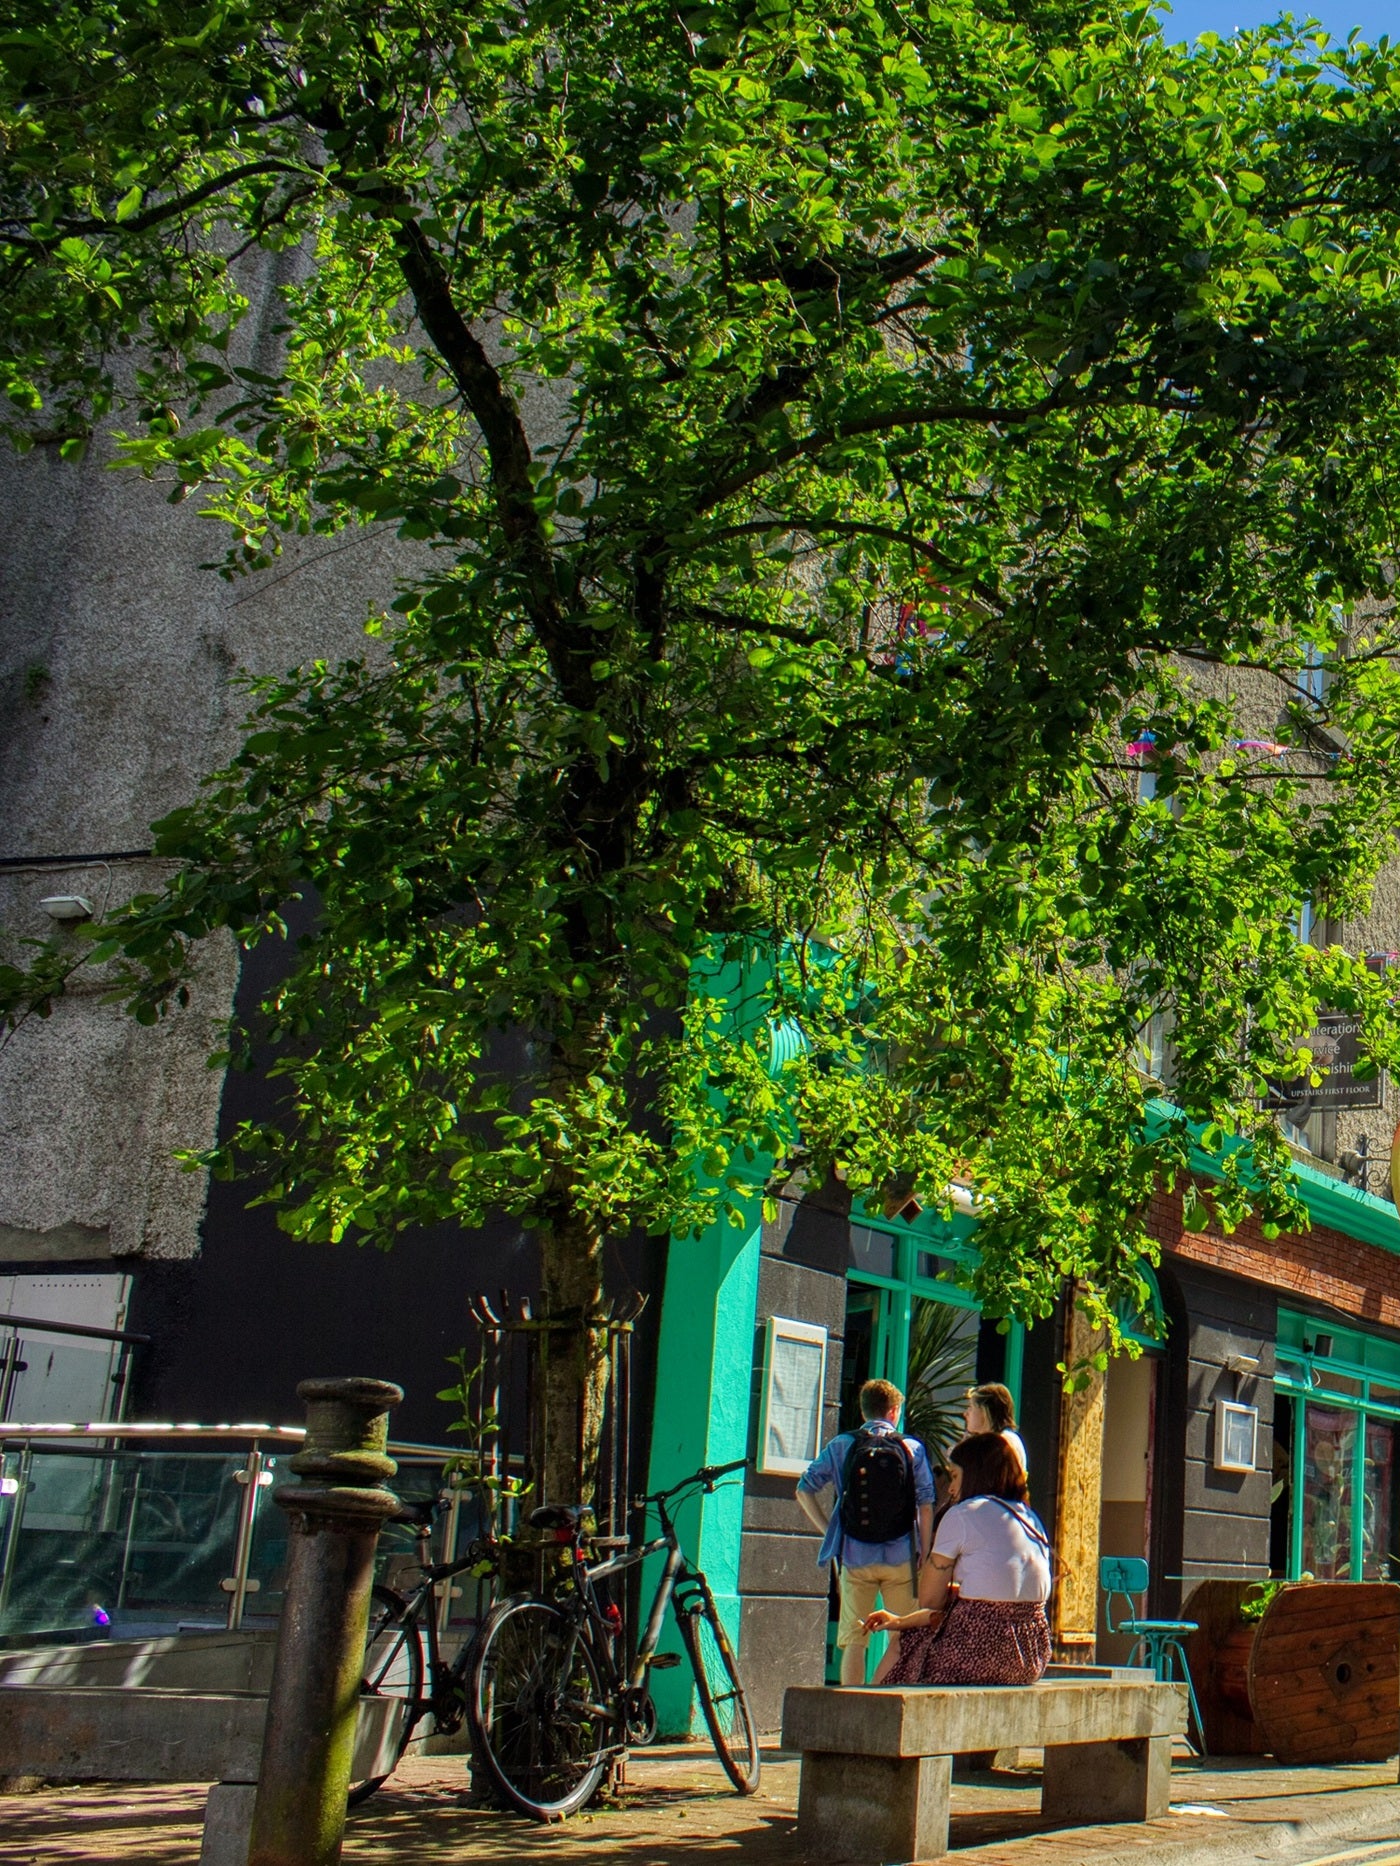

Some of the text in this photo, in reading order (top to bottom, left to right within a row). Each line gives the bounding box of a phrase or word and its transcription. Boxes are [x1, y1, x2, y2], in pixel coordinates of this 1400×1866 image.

[1291, 1085, 1370, 1097] UPSTAIRS FIRST FLOOR
